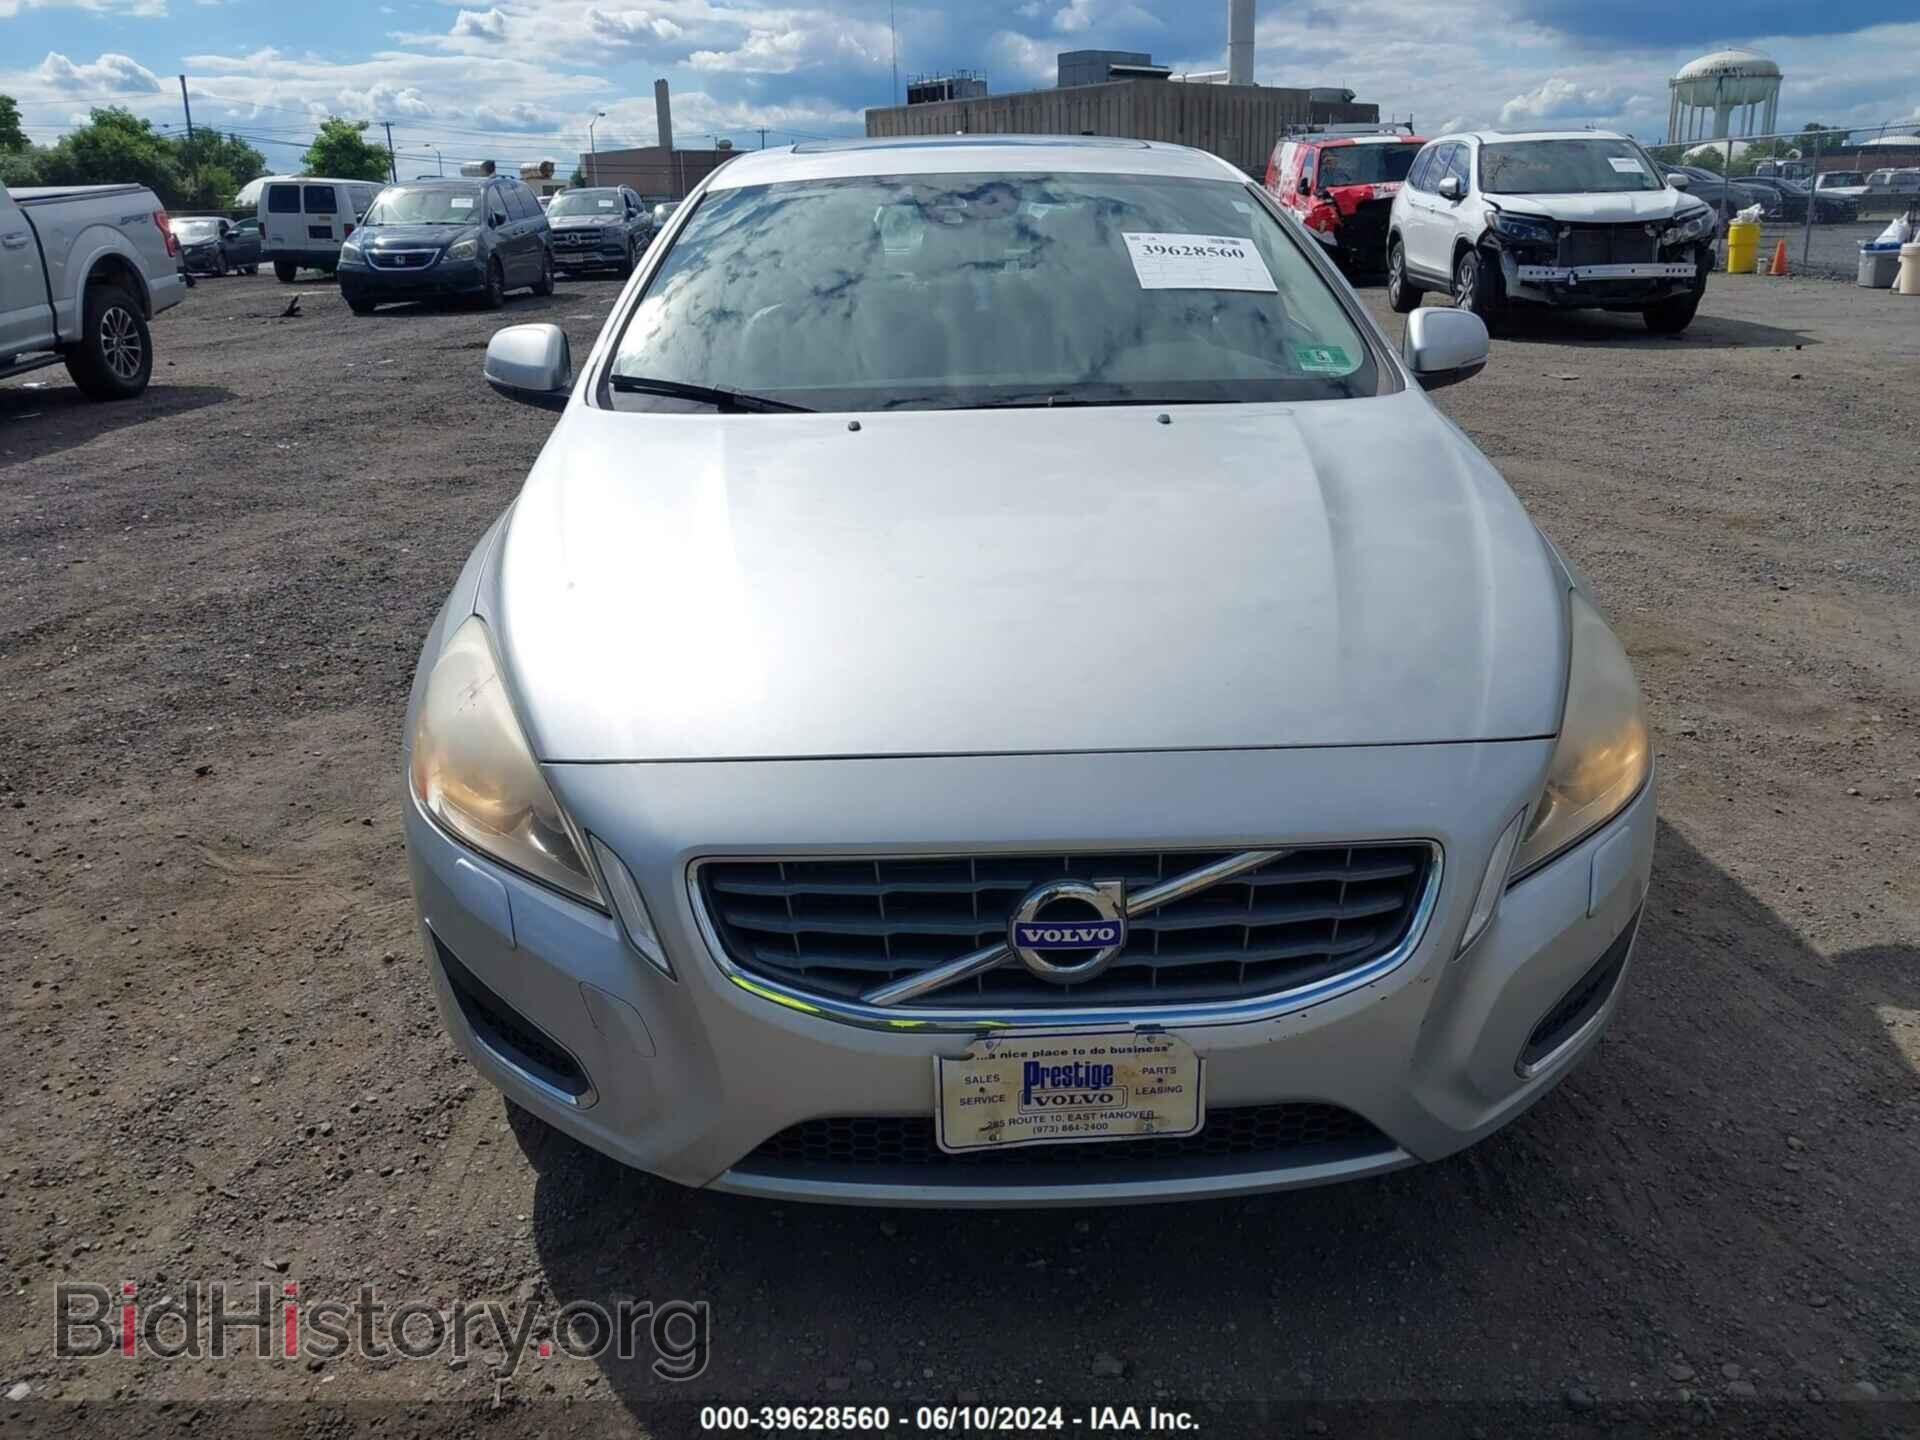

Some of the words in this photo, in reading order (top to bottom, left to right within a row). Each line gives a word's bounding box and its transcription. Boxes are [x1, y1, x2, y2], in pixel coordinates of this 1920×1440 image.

[1141, 243, 1245, 259] 39628560
[1020, 927, 1115, 943] VOLVO
[1000, 1050, 1028, 1059] nice
[1032, 1048, 1068, 1058] place
[1072, 1047, 1086, 1055] to
[1090, 1047, 1106, 1055] do
[1142, 1066, 1177, 1075] PARTS
[964, 1073, 1000, 1085] SALES
[1023, 1061, 1114, 1105] Prestige
[1135, 1084, 1183, 1096] LEASING
[959, 1094, 1006, 1106] SERVICE
[1033, 1093, 1114, 1106] VOLVO
[1008, 1116, 1046, 1126] ROUTE
[1067, 1112, 1096, 1121] EAST
[1100, 1110, 1154, 1121] HANOVER
[1033, 1124, 1060, 1135] (973)
